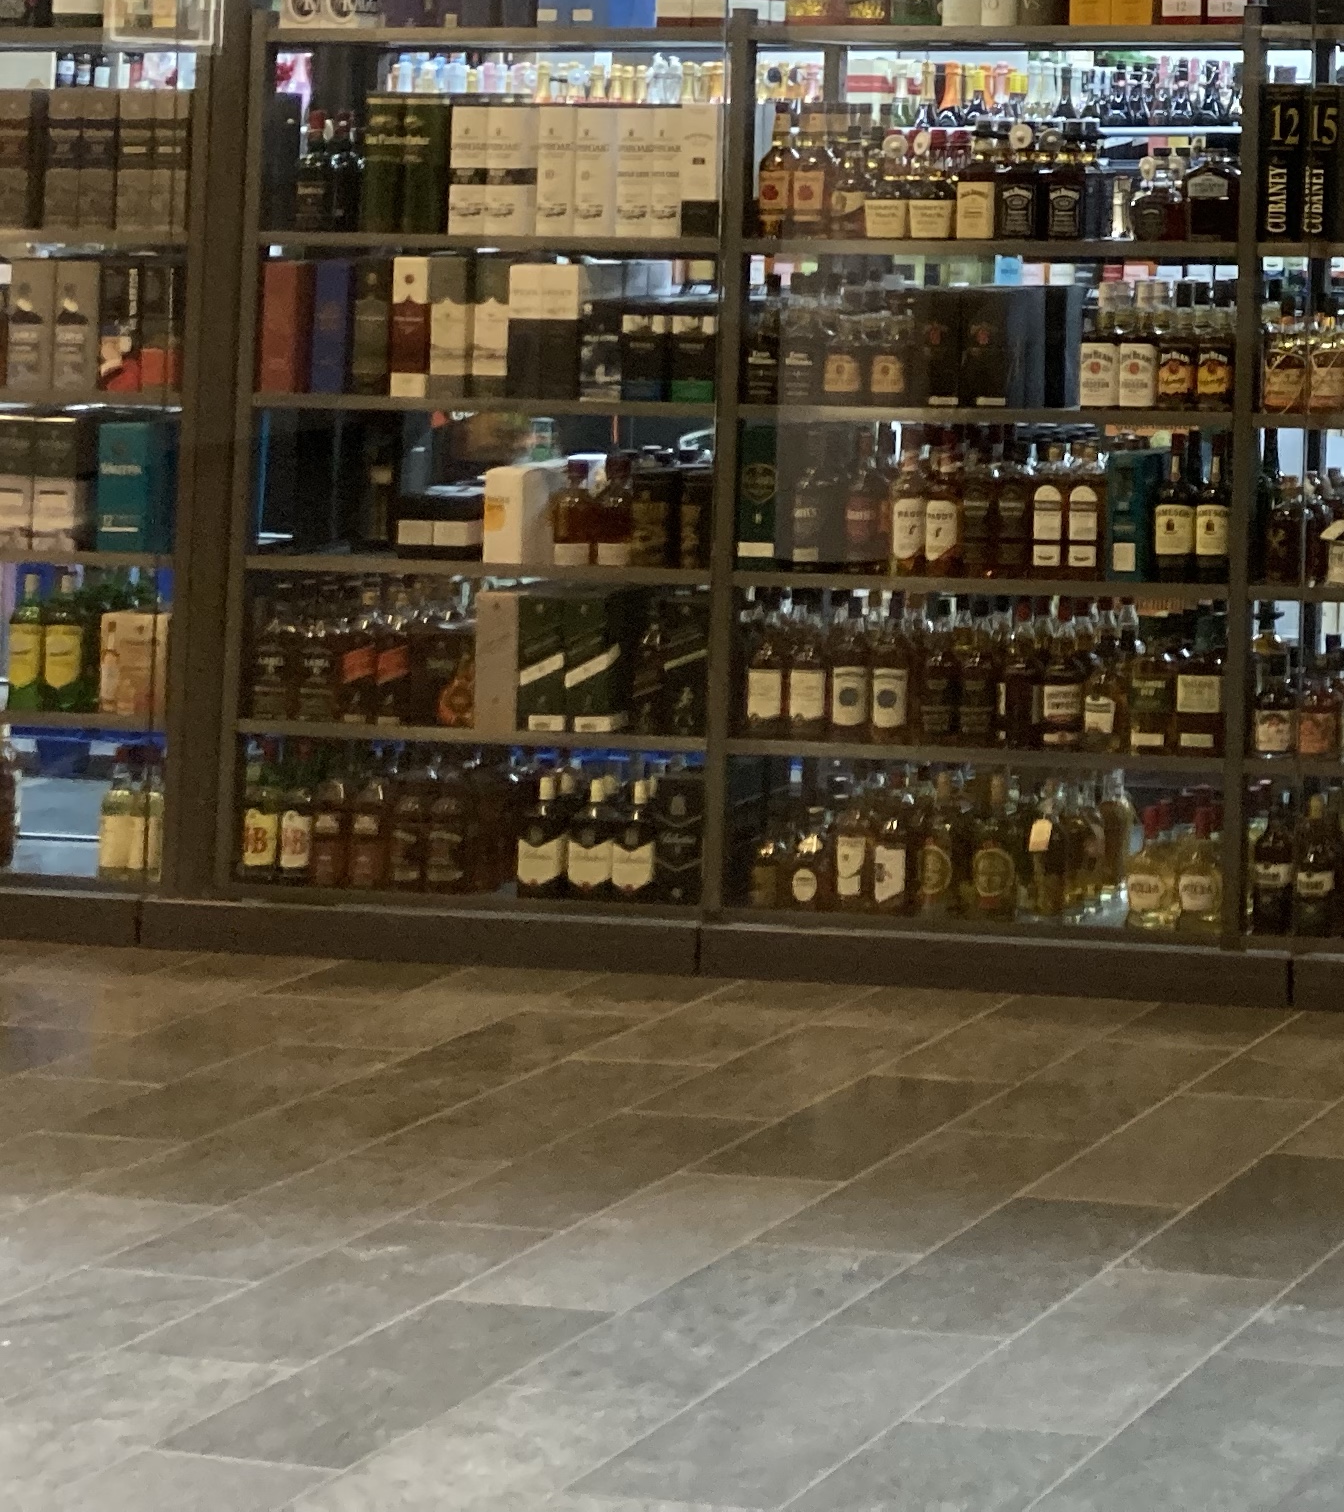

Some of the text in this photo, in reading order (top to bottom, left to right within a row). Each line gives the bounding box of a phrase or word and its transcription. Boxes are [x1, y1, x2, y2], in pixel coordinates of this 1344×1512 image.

[1175, 0, 1188, 13] 12
[1220, 0, 1233, 13] 12
[1271, 104, 1300, 145] 12
[1267, 163, 1287, 234] CUBANEY
